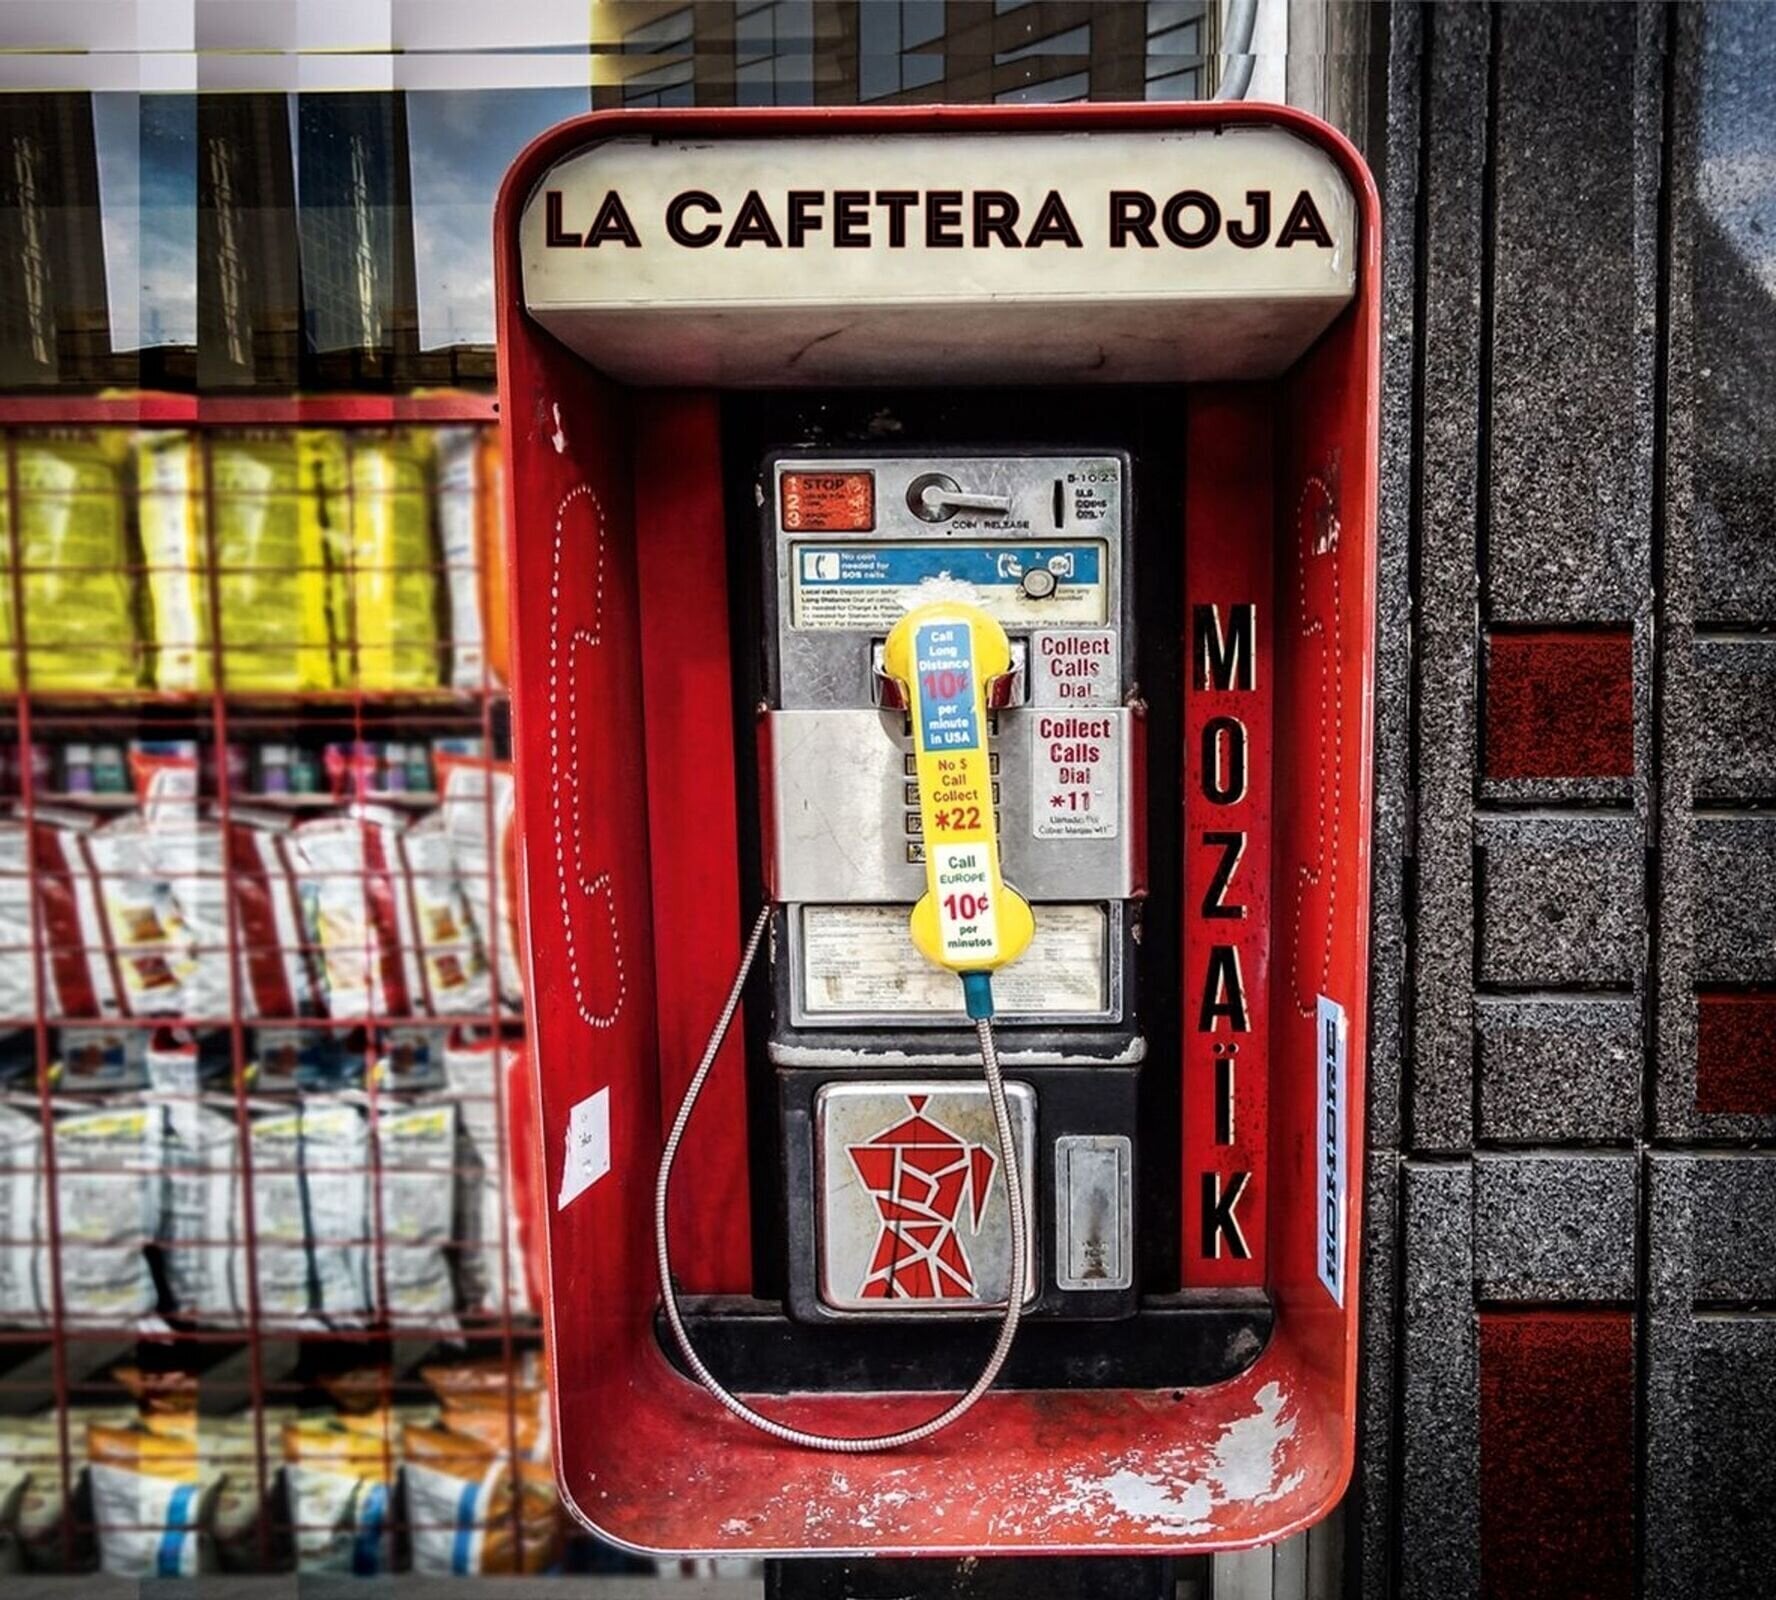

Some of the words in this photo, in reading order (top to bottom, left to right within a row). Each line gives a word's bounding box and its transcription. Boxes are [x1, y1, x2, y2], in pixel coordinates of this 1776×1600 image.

[545, 190, 641, 247] LA
[665, 190, 1084, 248] CAFETERA
[1109, 190, 1333, 248] ROJA
[803, 479, 845, 490] STOP
[952, 521, 976, 529] COIN
[984, 521, 1030, 529] RELEASE
[931, 630, 954, 642] Call
[929, 646, 958, 657] Long
[1042, 636, 1110, 655] Collect
[919, 659, 970, 671] Distance
[1051, 658, 1100, 677] Calls
[924, 671, 968, 700] 10¢
[1060, 683, 1091, 698] Dial
[938, 705, 958, 716] per
[929, 718, 969, 730] minute
[1040, 718, 1111, 739] Collect
[930, 734, 942, 744] in
[945, 732, 970, 743] USA
[1050, 743, 1100, 763] Calls
[938, 759, 956, 771] No
[942, 775, 966, 787] Call
[1059, 767, 1091, 784] Dial
[933, 790, 979, 803] Collect
[948, 855, 976, 869] Call
[940, 872, 985, 884] EUROPE
[944, 892, 990, 920] 10¢
[1193, 603, 1256, 1259] MOZAÏK
[947, 938, 992, 949] minutos
